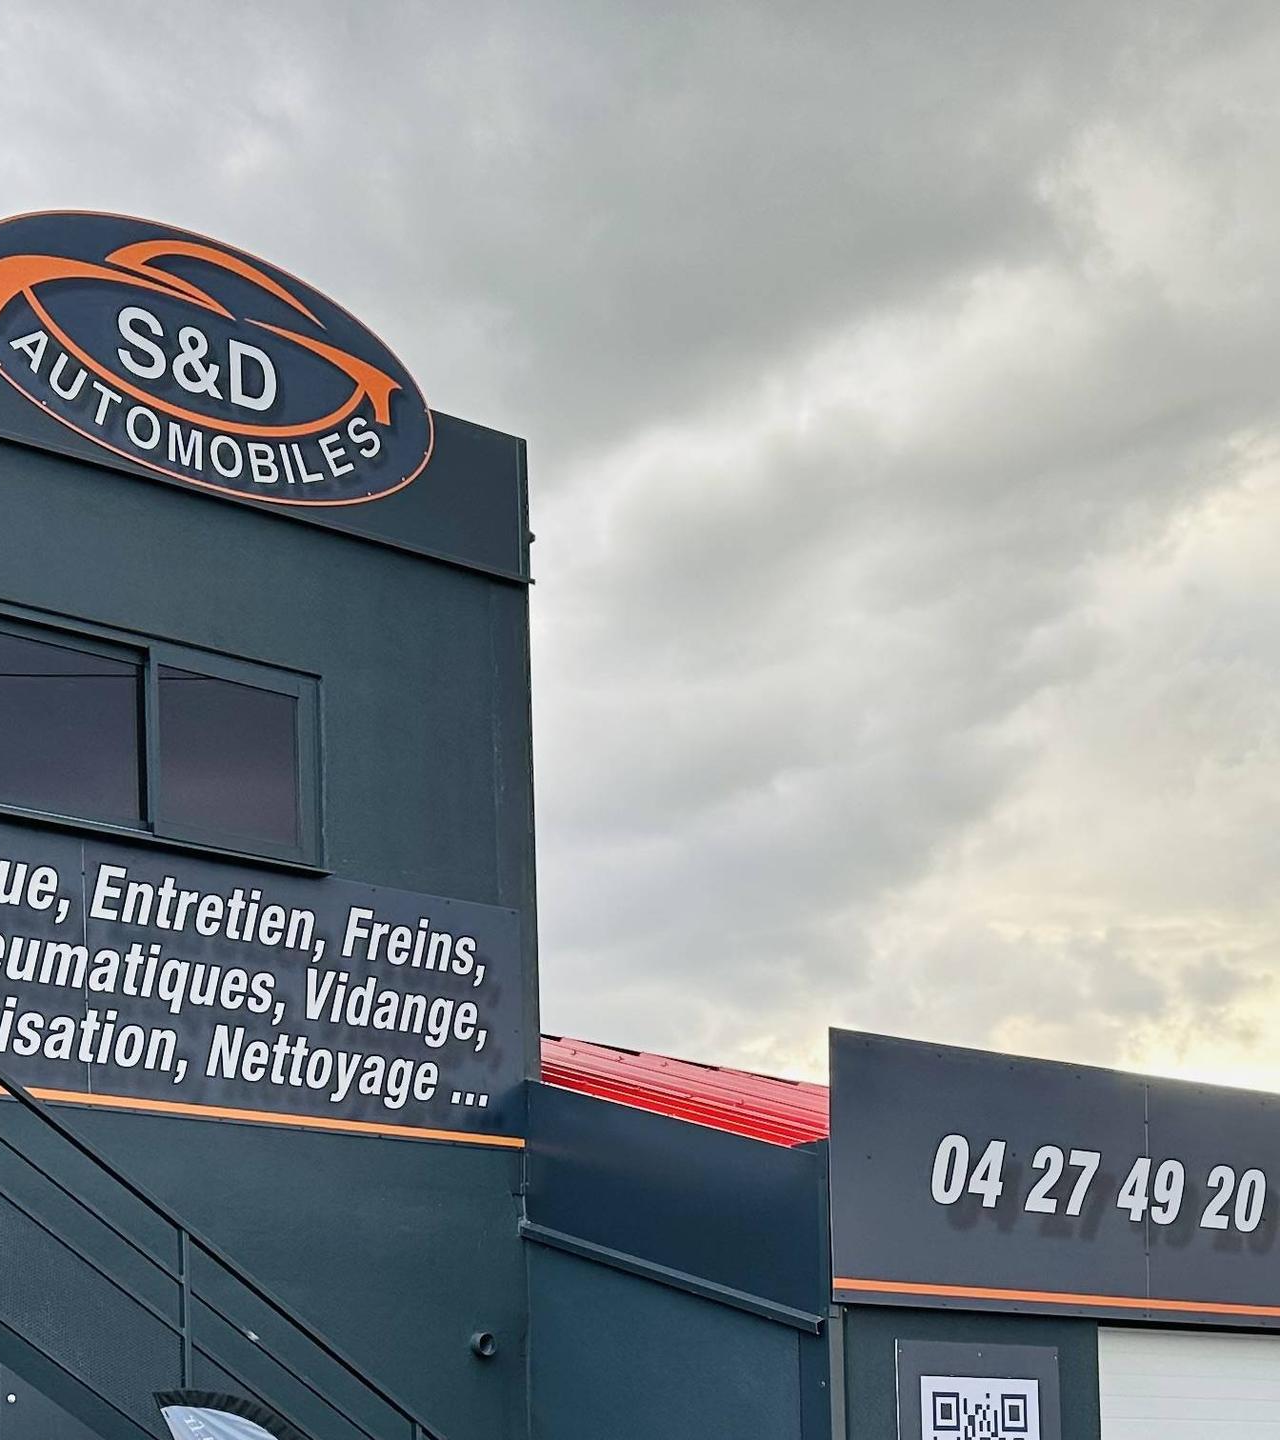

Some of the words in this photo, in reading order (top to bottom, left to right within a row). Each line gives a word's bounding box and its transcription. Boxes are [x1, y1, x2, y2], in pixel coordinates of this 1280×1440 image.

[9, 329, 381, 485] AUTOMOBILES
[117, 305, 277, 412] S&D
[89, 863, 326, 963] Entretien,
[340, 906, 486, 987] Freins,
[305, 966, 487, 1052] Vidange,
[205, 1023, 438, 1109] Nettoyage
[930, 1133, 1006, 1209] 04
[1024, 1144, 1101, 1217] 27
[1116, 1156, 1185, 1226] 49
[1199, 1165, 1266, 1233] 20
